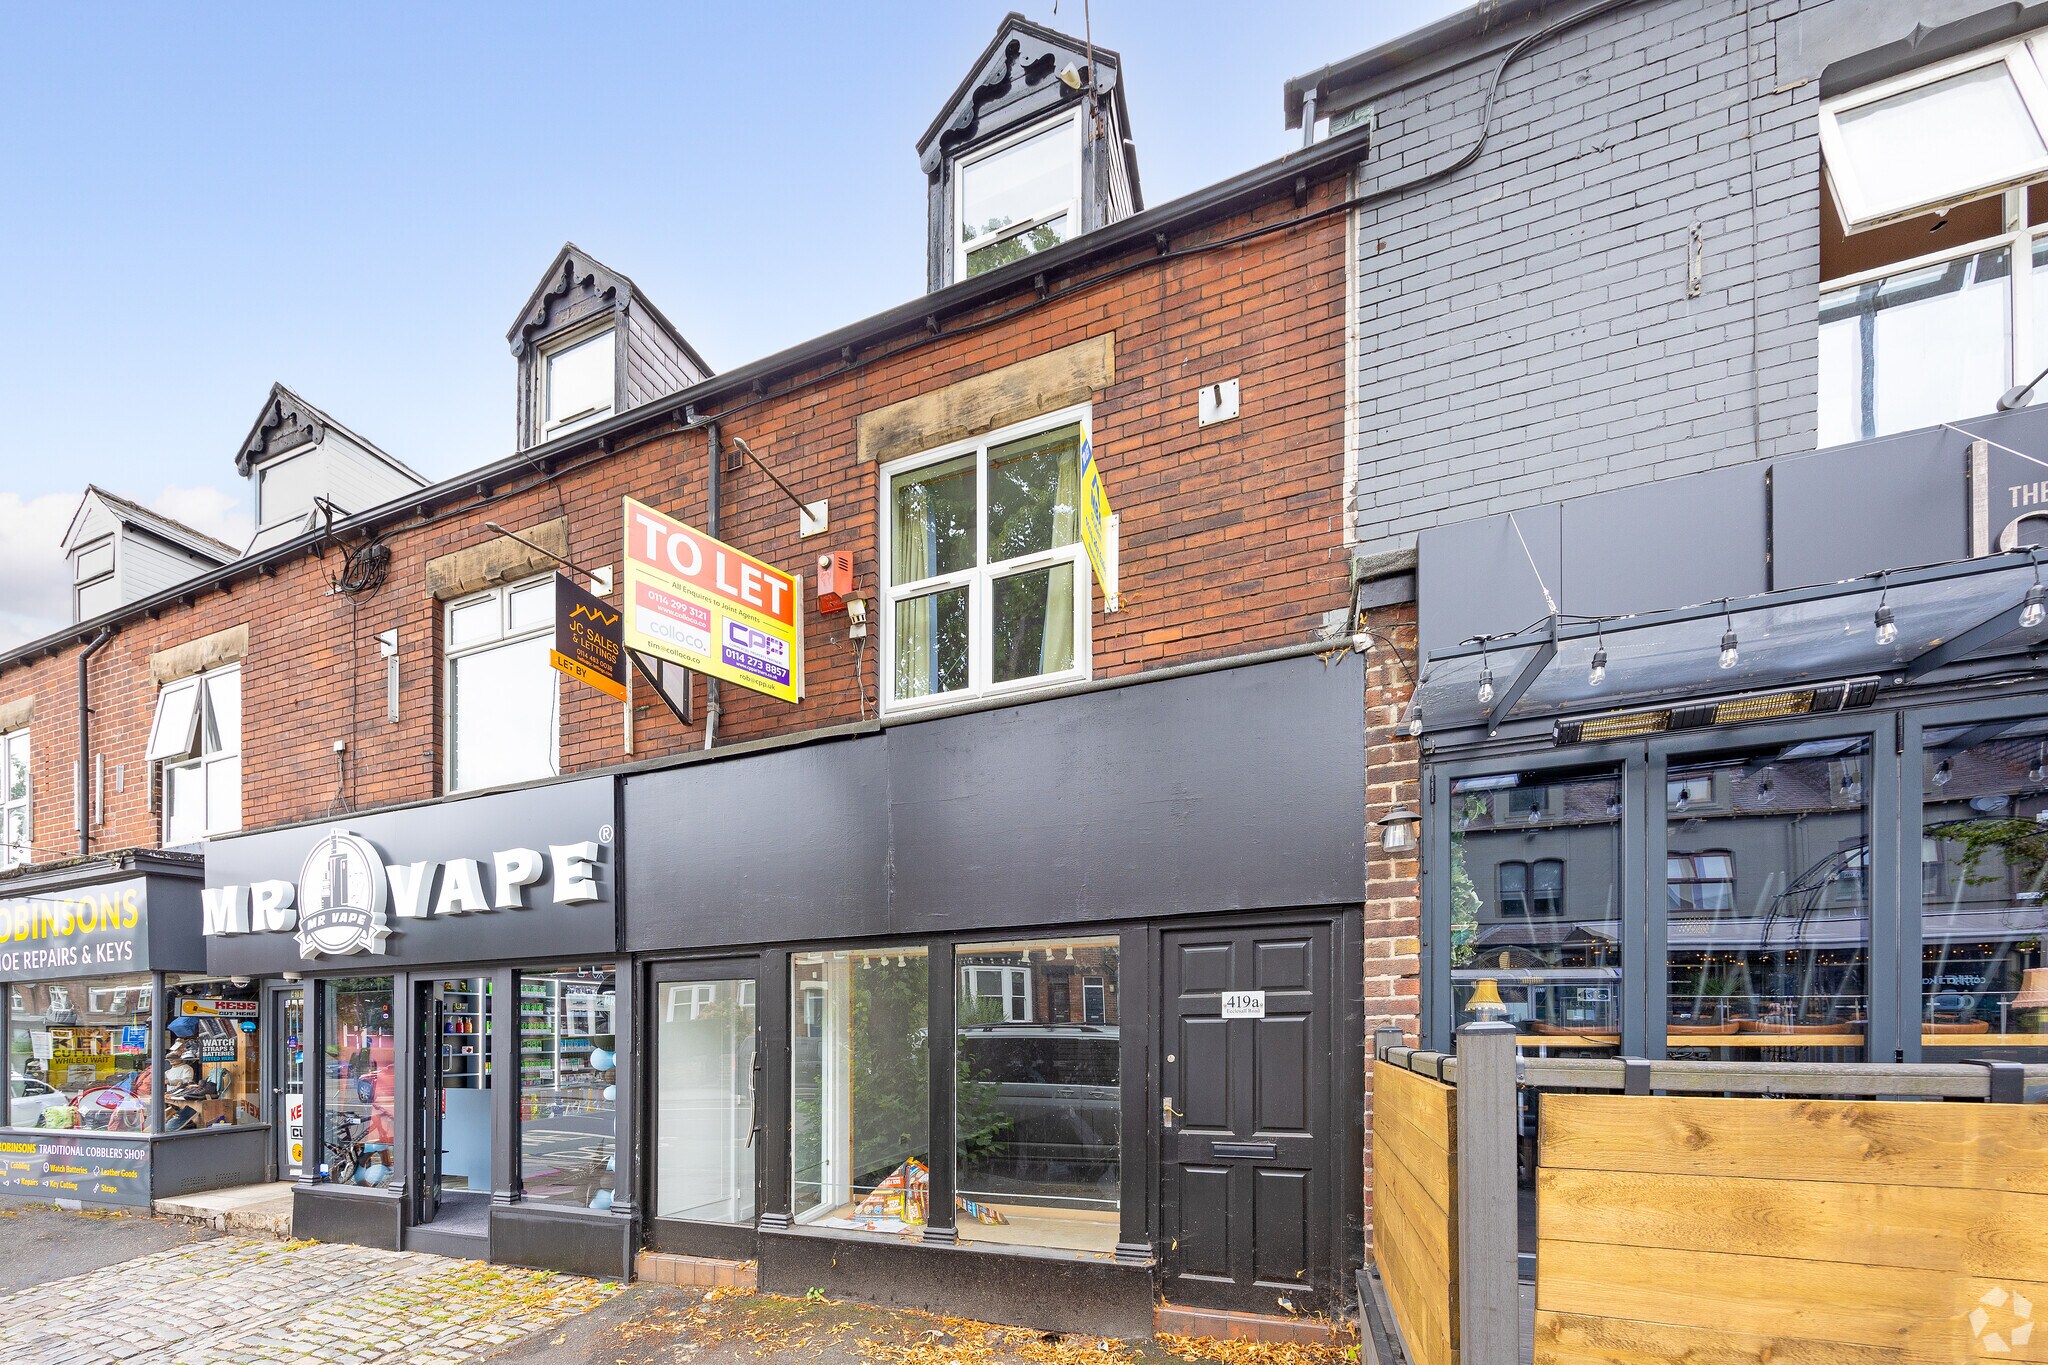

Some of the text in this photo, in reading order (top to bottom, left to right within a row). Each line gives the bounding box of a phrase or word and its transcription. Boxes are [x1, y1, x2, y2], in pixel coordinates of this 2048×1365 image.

[636, 513, 788, 615] TO LET
[648, 590, 707, 620] 0114 299 3121
[672, 581, 761, 623] All Enquires to Joint Agents
[657, 605, 707, 628] www.colloco.co
[569, 620, 619, 656] JC SALES
[572, 633, 617, 664] & LETTINGS
[576, 648, 589, 660] 0114
[557, 656, 574, 671] LET
[576, 665, 587, 678] BY
[725, 648, 787, 678] 0114 273 8857
[201, 879, 296, 936] MR
[385, 841, 599, 919] VAPE
[306, 912, 368, 931] MR VAPE
[0, 940, 133, 971] OE REPAIRS & KEYS
[215, 1001, 256, 1010] KEYS
[1226, 994, 1259, 1009] 419a
[52, 1037, 111, 1049] KEY
[202, 1038, 235, 1047] WATCH
[290, 1103, 303, 1122] KE
[0, 1141, 145, 1160] OBINSONS TRADITIONAL COBBLERS SHOP
[50, 1164, 66, 1173] Watch
[66, 1165, 88, 1175] Batteries
[101, 1167, 120, 1177] Leather
[120, 1168, 138, 1179] Goods
[21, 1177, 118, 1194] Repairs Key Cutting Straps
